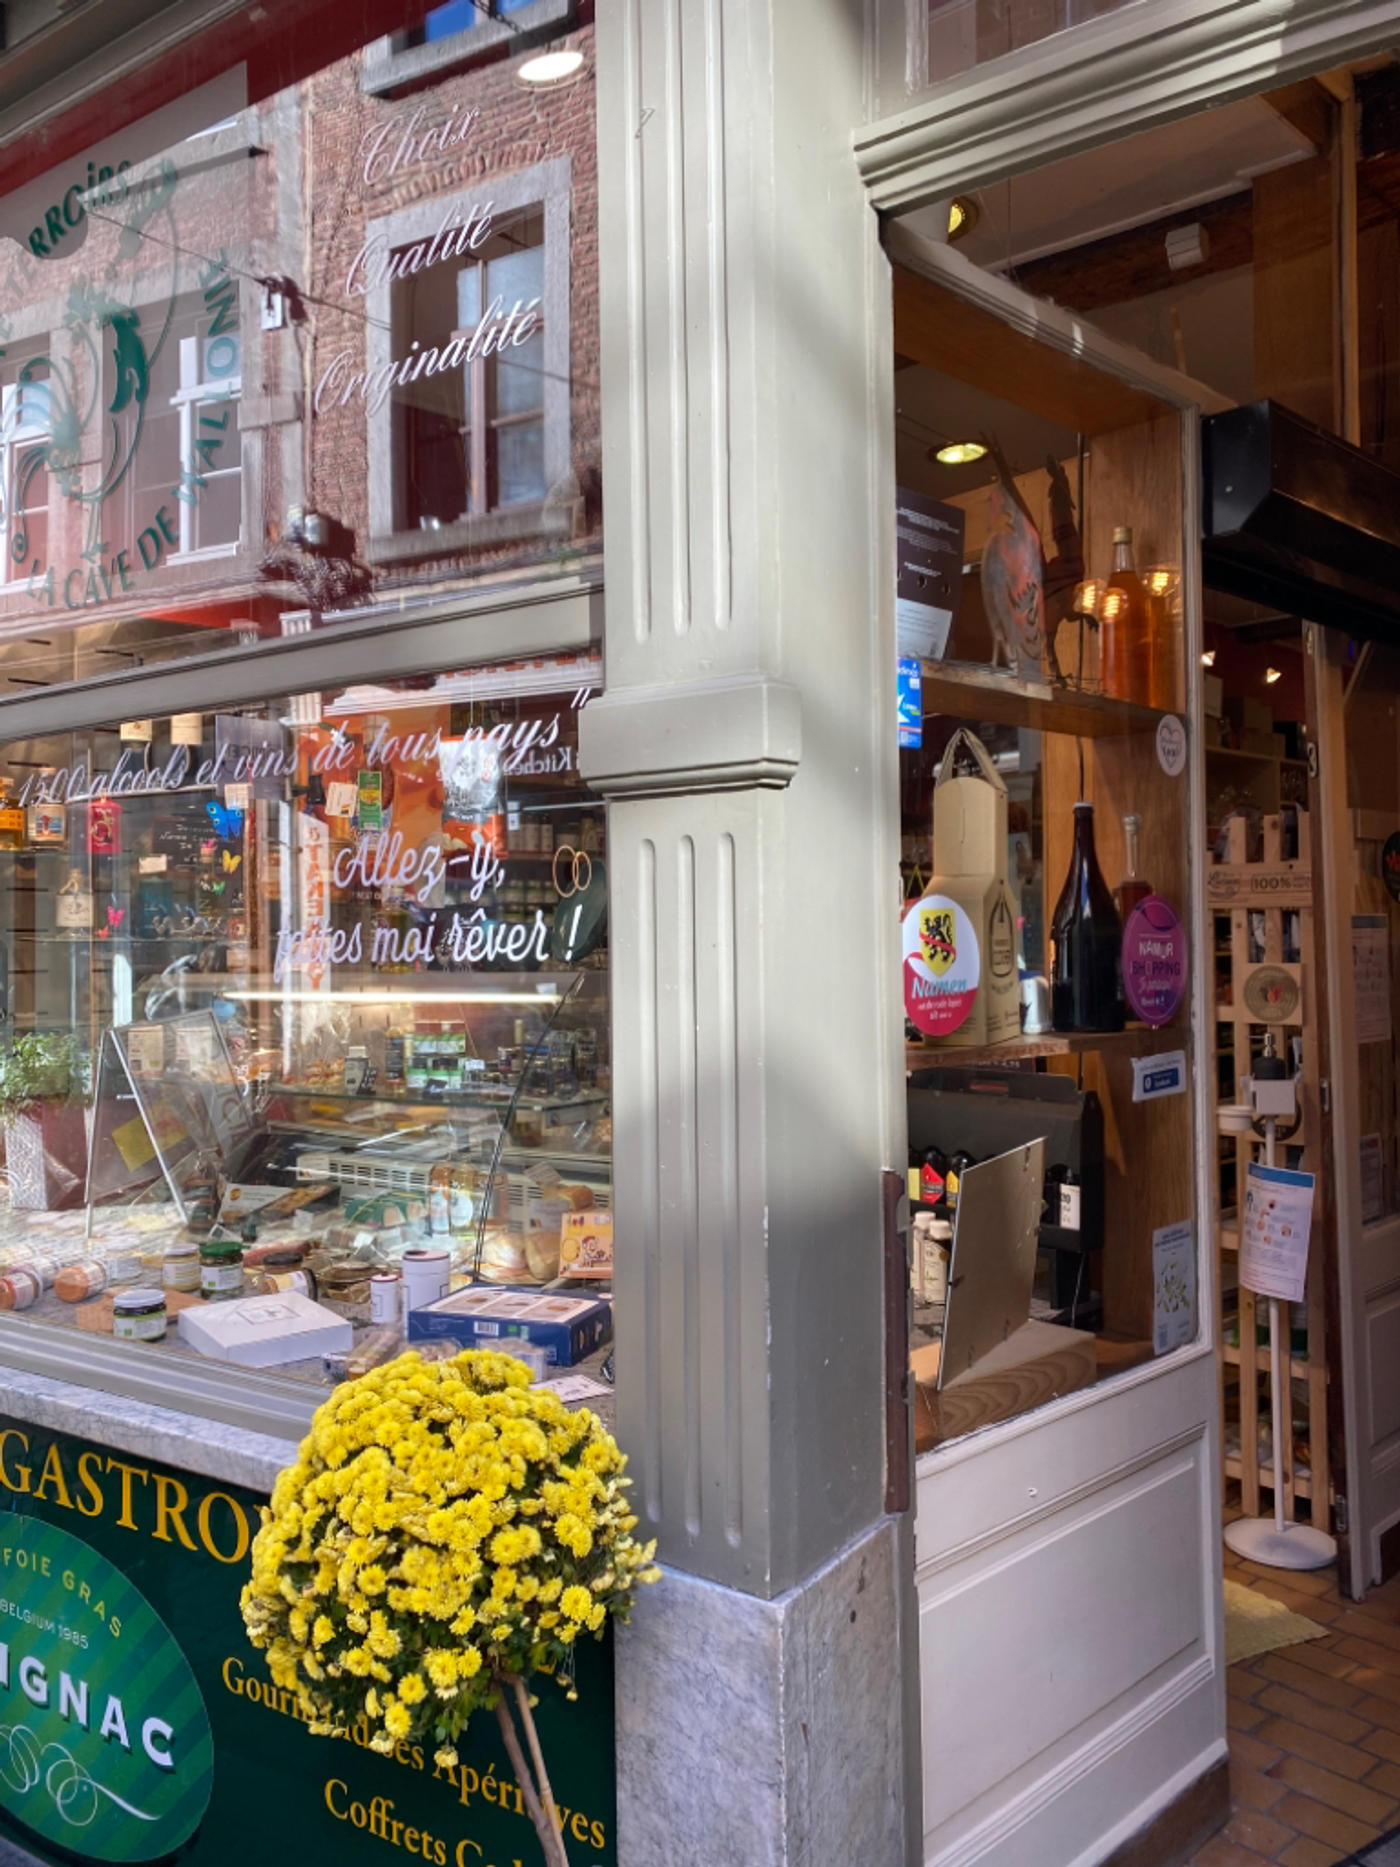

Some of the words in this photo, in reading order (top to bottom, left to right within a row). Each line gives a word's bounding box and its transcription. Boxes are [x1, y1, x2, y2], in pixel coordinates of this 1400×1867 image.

[360, 105, 479, 185] Choix
[346, 201, 493, 297] Qualité
[314, 295, 541, 416] Originalité
[63, 549, 136, 610] CAVE
[137, 505, 180, 571] DE
[88, 743, 190, 798] alcools
[233, 741, 299, 781] vins
[313, 719, 356, 772] de
[370, 912, 436, 963] moi
[446, 907, 549, 963] rêver
[0, 1429, 260, 1564] GASTRO
[0, 1597, 56, 1634] BELGIUM
[58, 1623, 89, 1650] 1985
[4, 1548, 51, 1577] FOIE
[62, 1569, 122, 1638] GRAS
[324, 1778, 447, 1866] Coffrets
